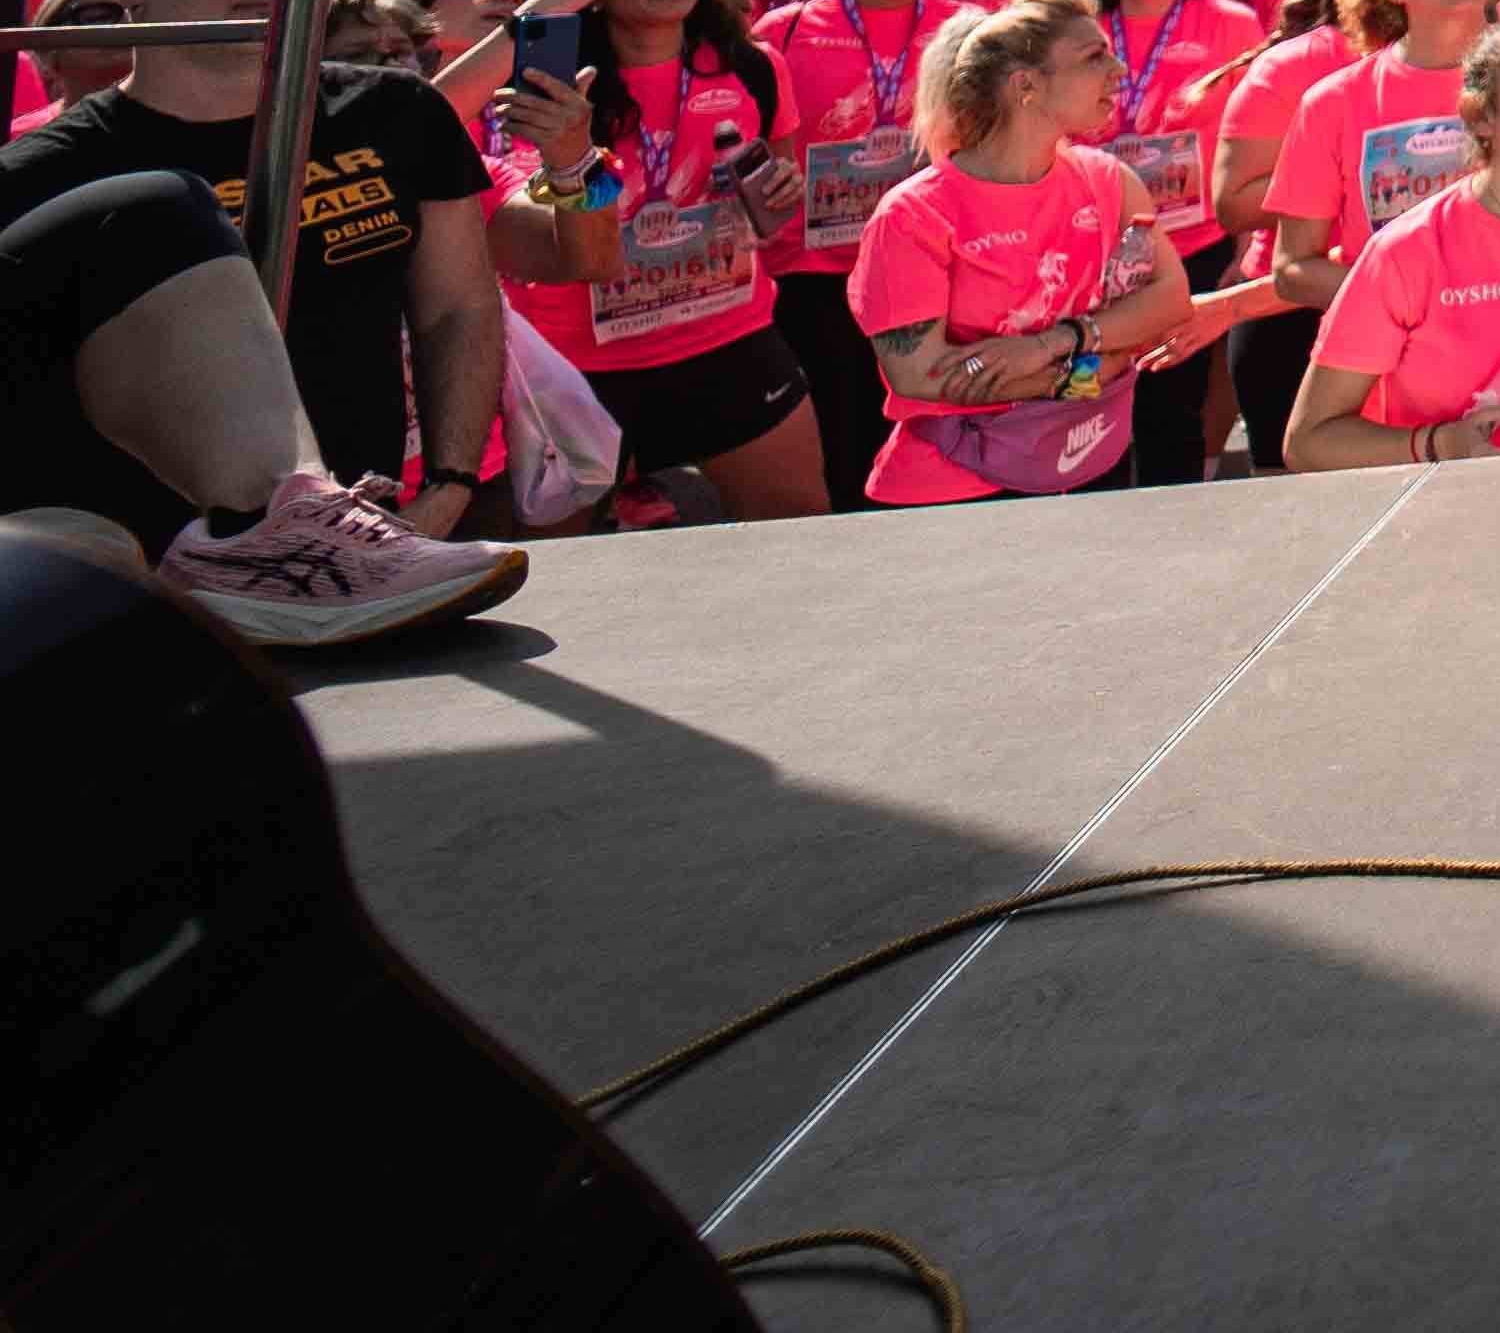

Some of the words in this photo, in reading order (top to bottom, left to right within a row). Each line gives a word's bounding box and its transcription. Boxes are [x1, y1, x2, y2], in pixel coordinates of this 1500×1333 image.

[213, 146, 386, 210] SAR
[323, 209, 400, 244] DENIM
[1066, 413, 1105, 452] NIKE
